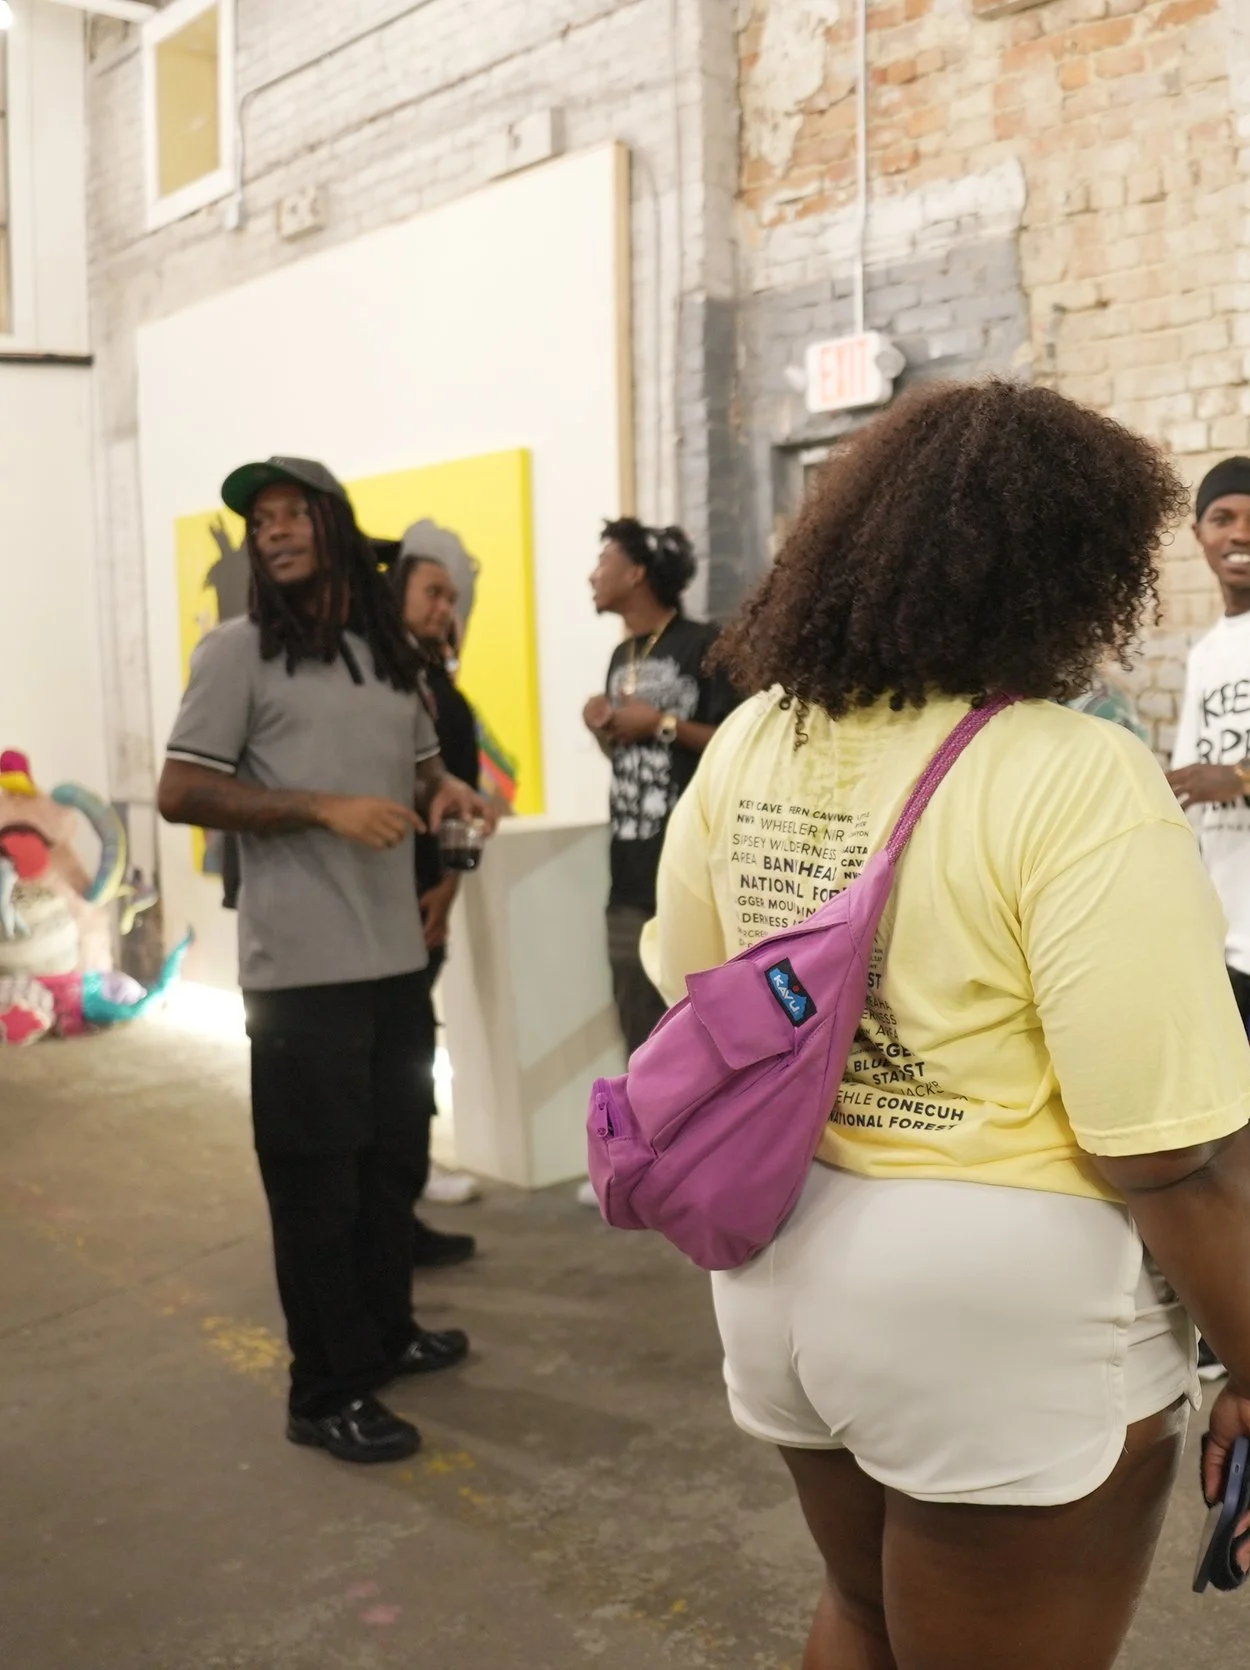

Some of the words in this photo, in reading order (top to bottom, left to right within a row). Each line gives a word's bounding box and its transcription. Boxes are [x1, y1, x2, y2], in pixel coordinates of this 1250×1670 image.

[756, 802, 783, 815] CAVE
[760, 818, 818, 838] WHEELER
[731, 851, 757, 865] AREA
[773, 974, 801, 1012] KAVU
[876, 1096, 965, 1122] CONECUH
